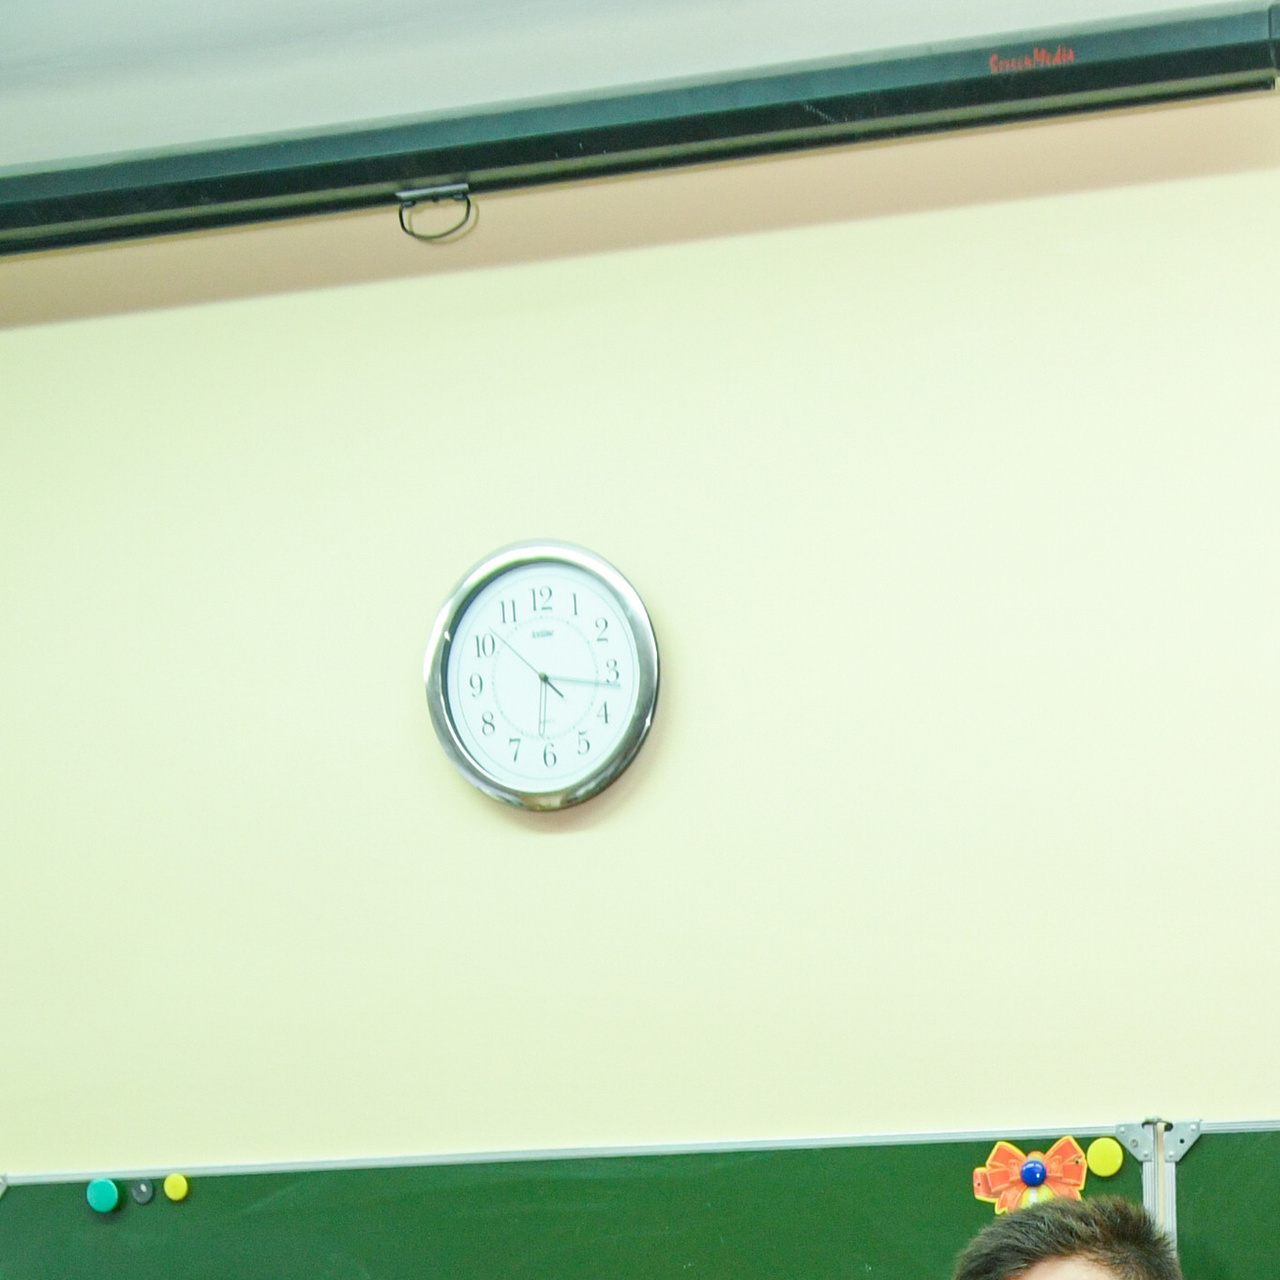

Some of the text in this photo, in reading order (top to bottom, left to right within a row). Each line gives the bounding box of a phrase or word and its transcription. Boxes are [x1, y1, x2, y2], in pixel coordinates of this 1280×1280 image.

[531, 586, 553, 611] 12
[571, 593, 578, 616] 1
[500, 599, 517, 624] 11
[595, 617, 608, 643] 2
[474, 632, 496, 658] 10
[605, 658, 620, 685] 3
[469, 672, 483, 698] 9
[481, 711, 496, 737] 8
[596, 701, 610, 724] 4
[508, 737, 521, 762] 7
[543, 742, 557, 768] 6
[576, 730, 591, 755] 5
